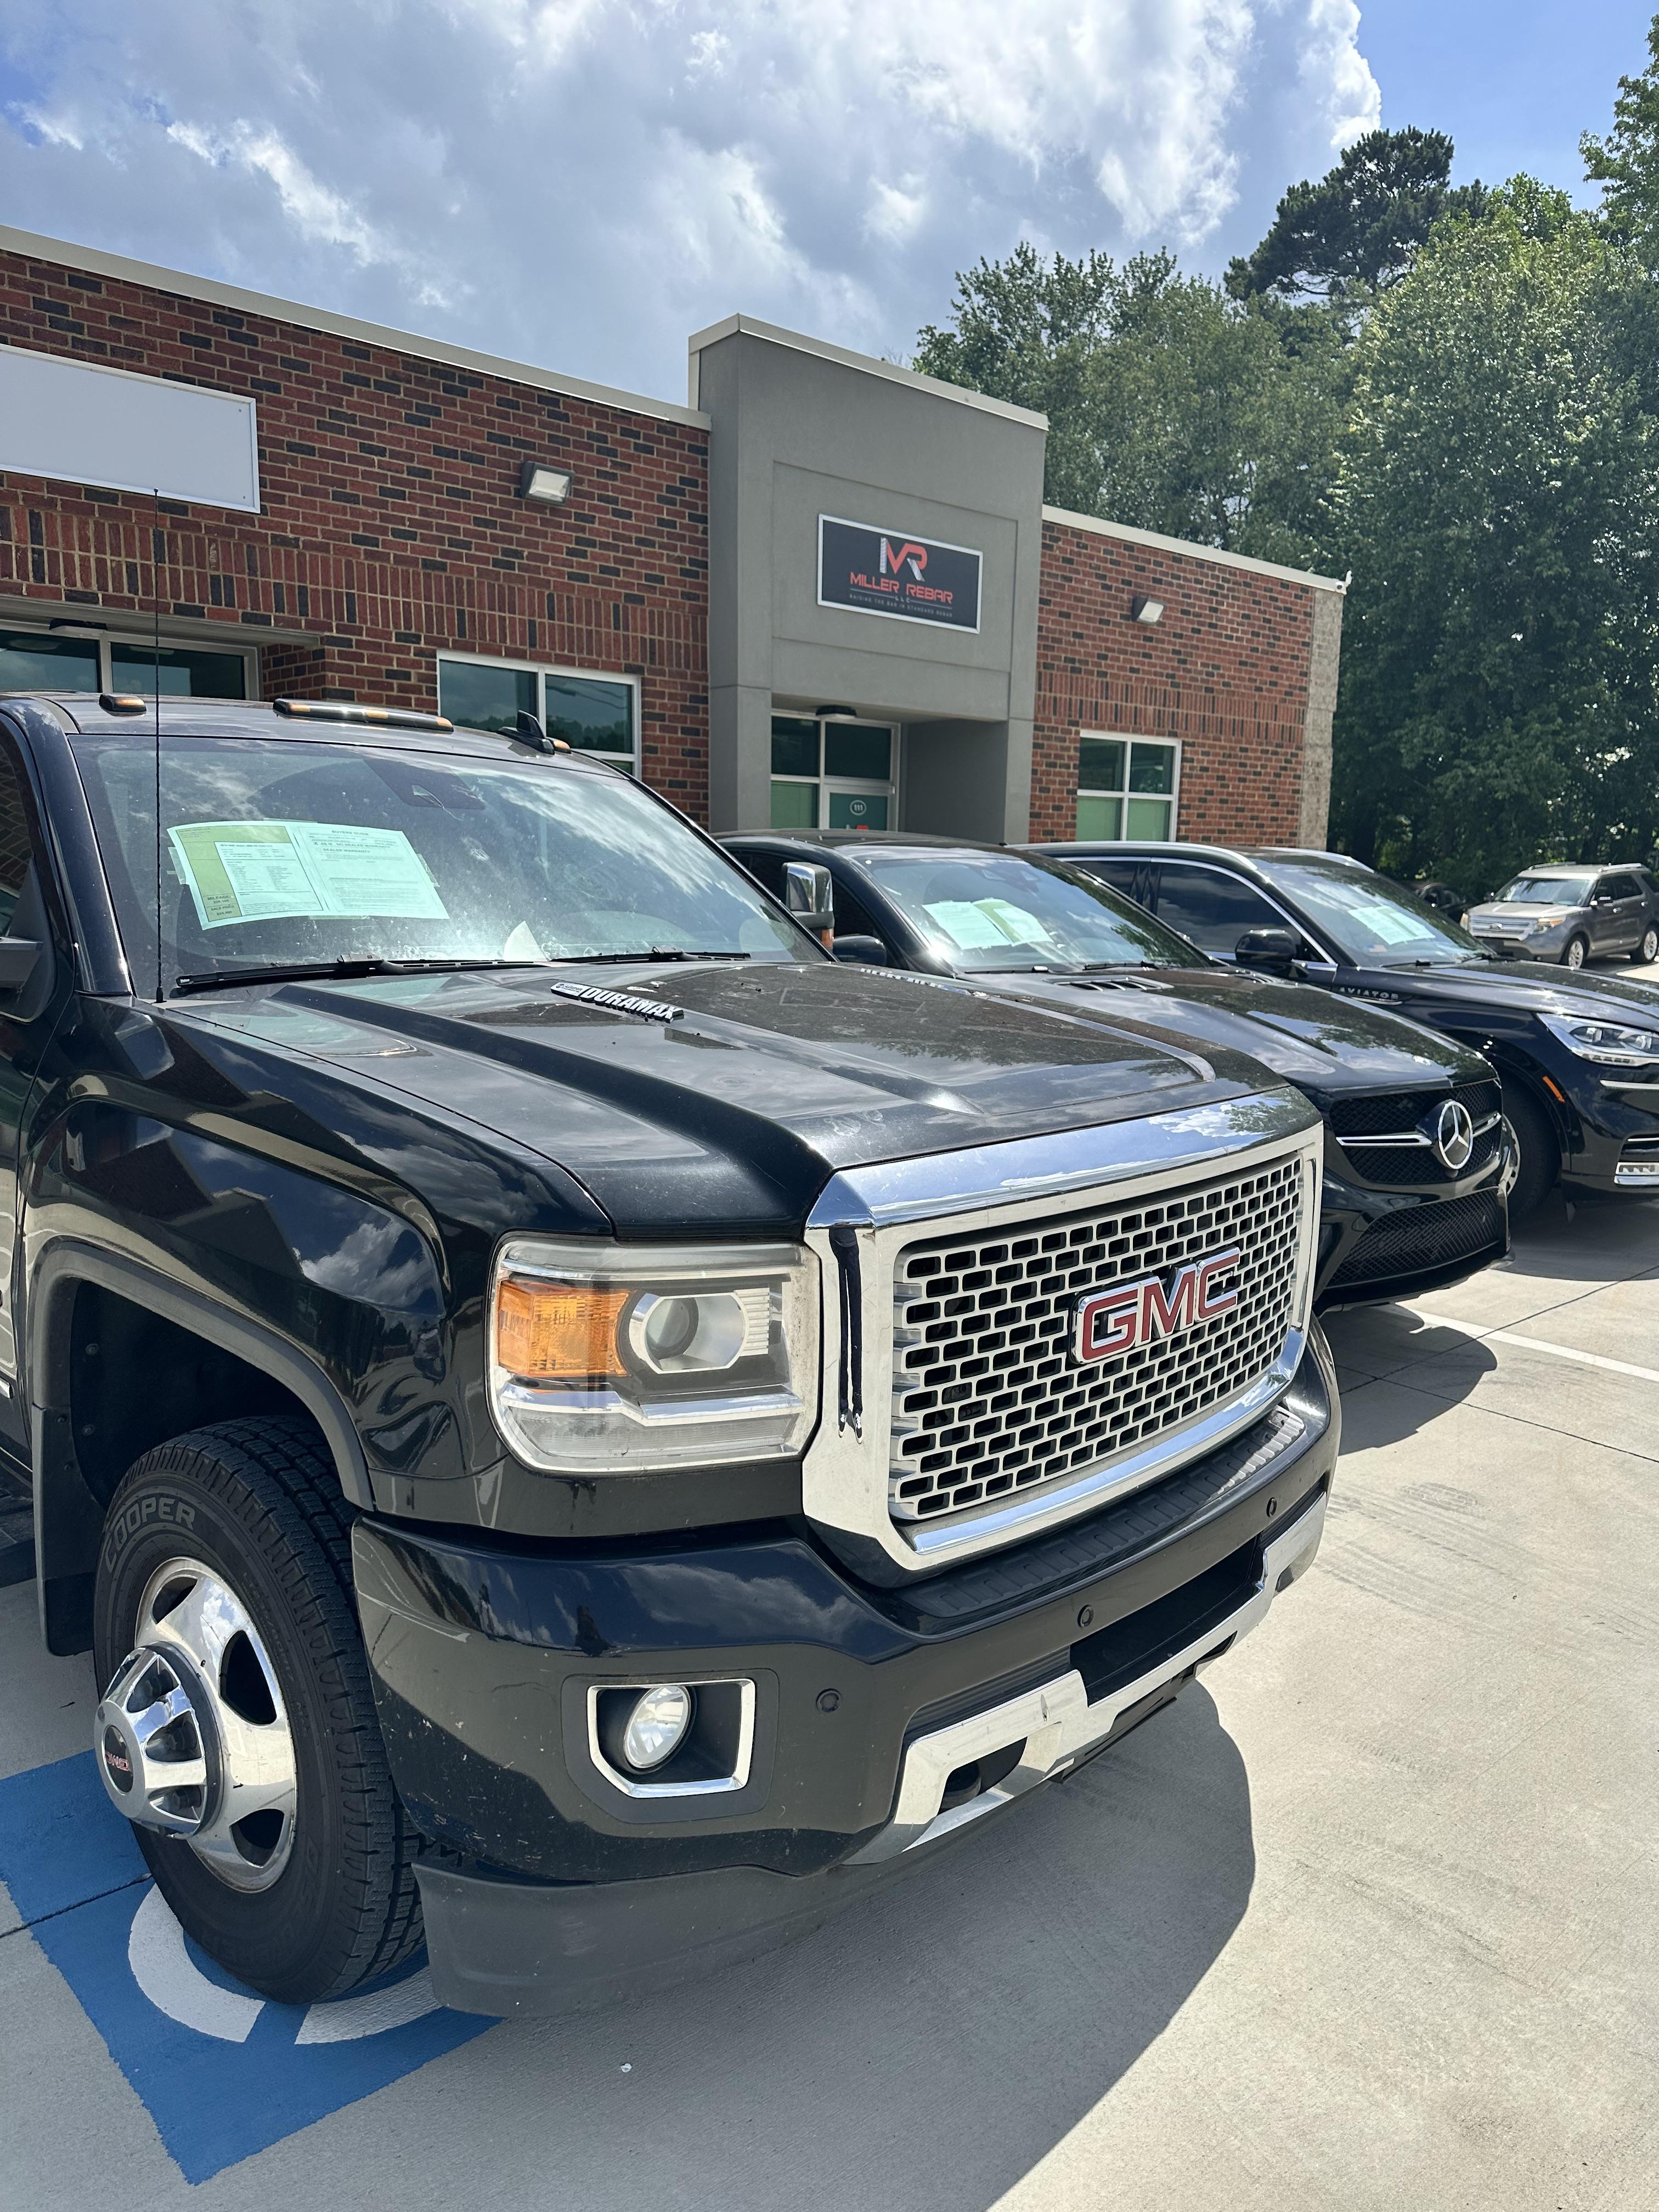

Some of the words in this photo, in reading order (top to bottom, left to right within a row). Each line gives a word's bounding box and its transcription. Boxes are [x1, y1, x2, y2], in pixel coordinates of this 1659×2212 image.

[850, 572, 900, 594] MILLER
[906, 583, 953, 604] REBAR
[580, 988, 684, 1022] DURAMAX
[1339, 987, 1399, 1000] AVIATOR
[1076, 1246, 1240, 1364] GMC
[105, 1496, 196, 1573] COOPER
